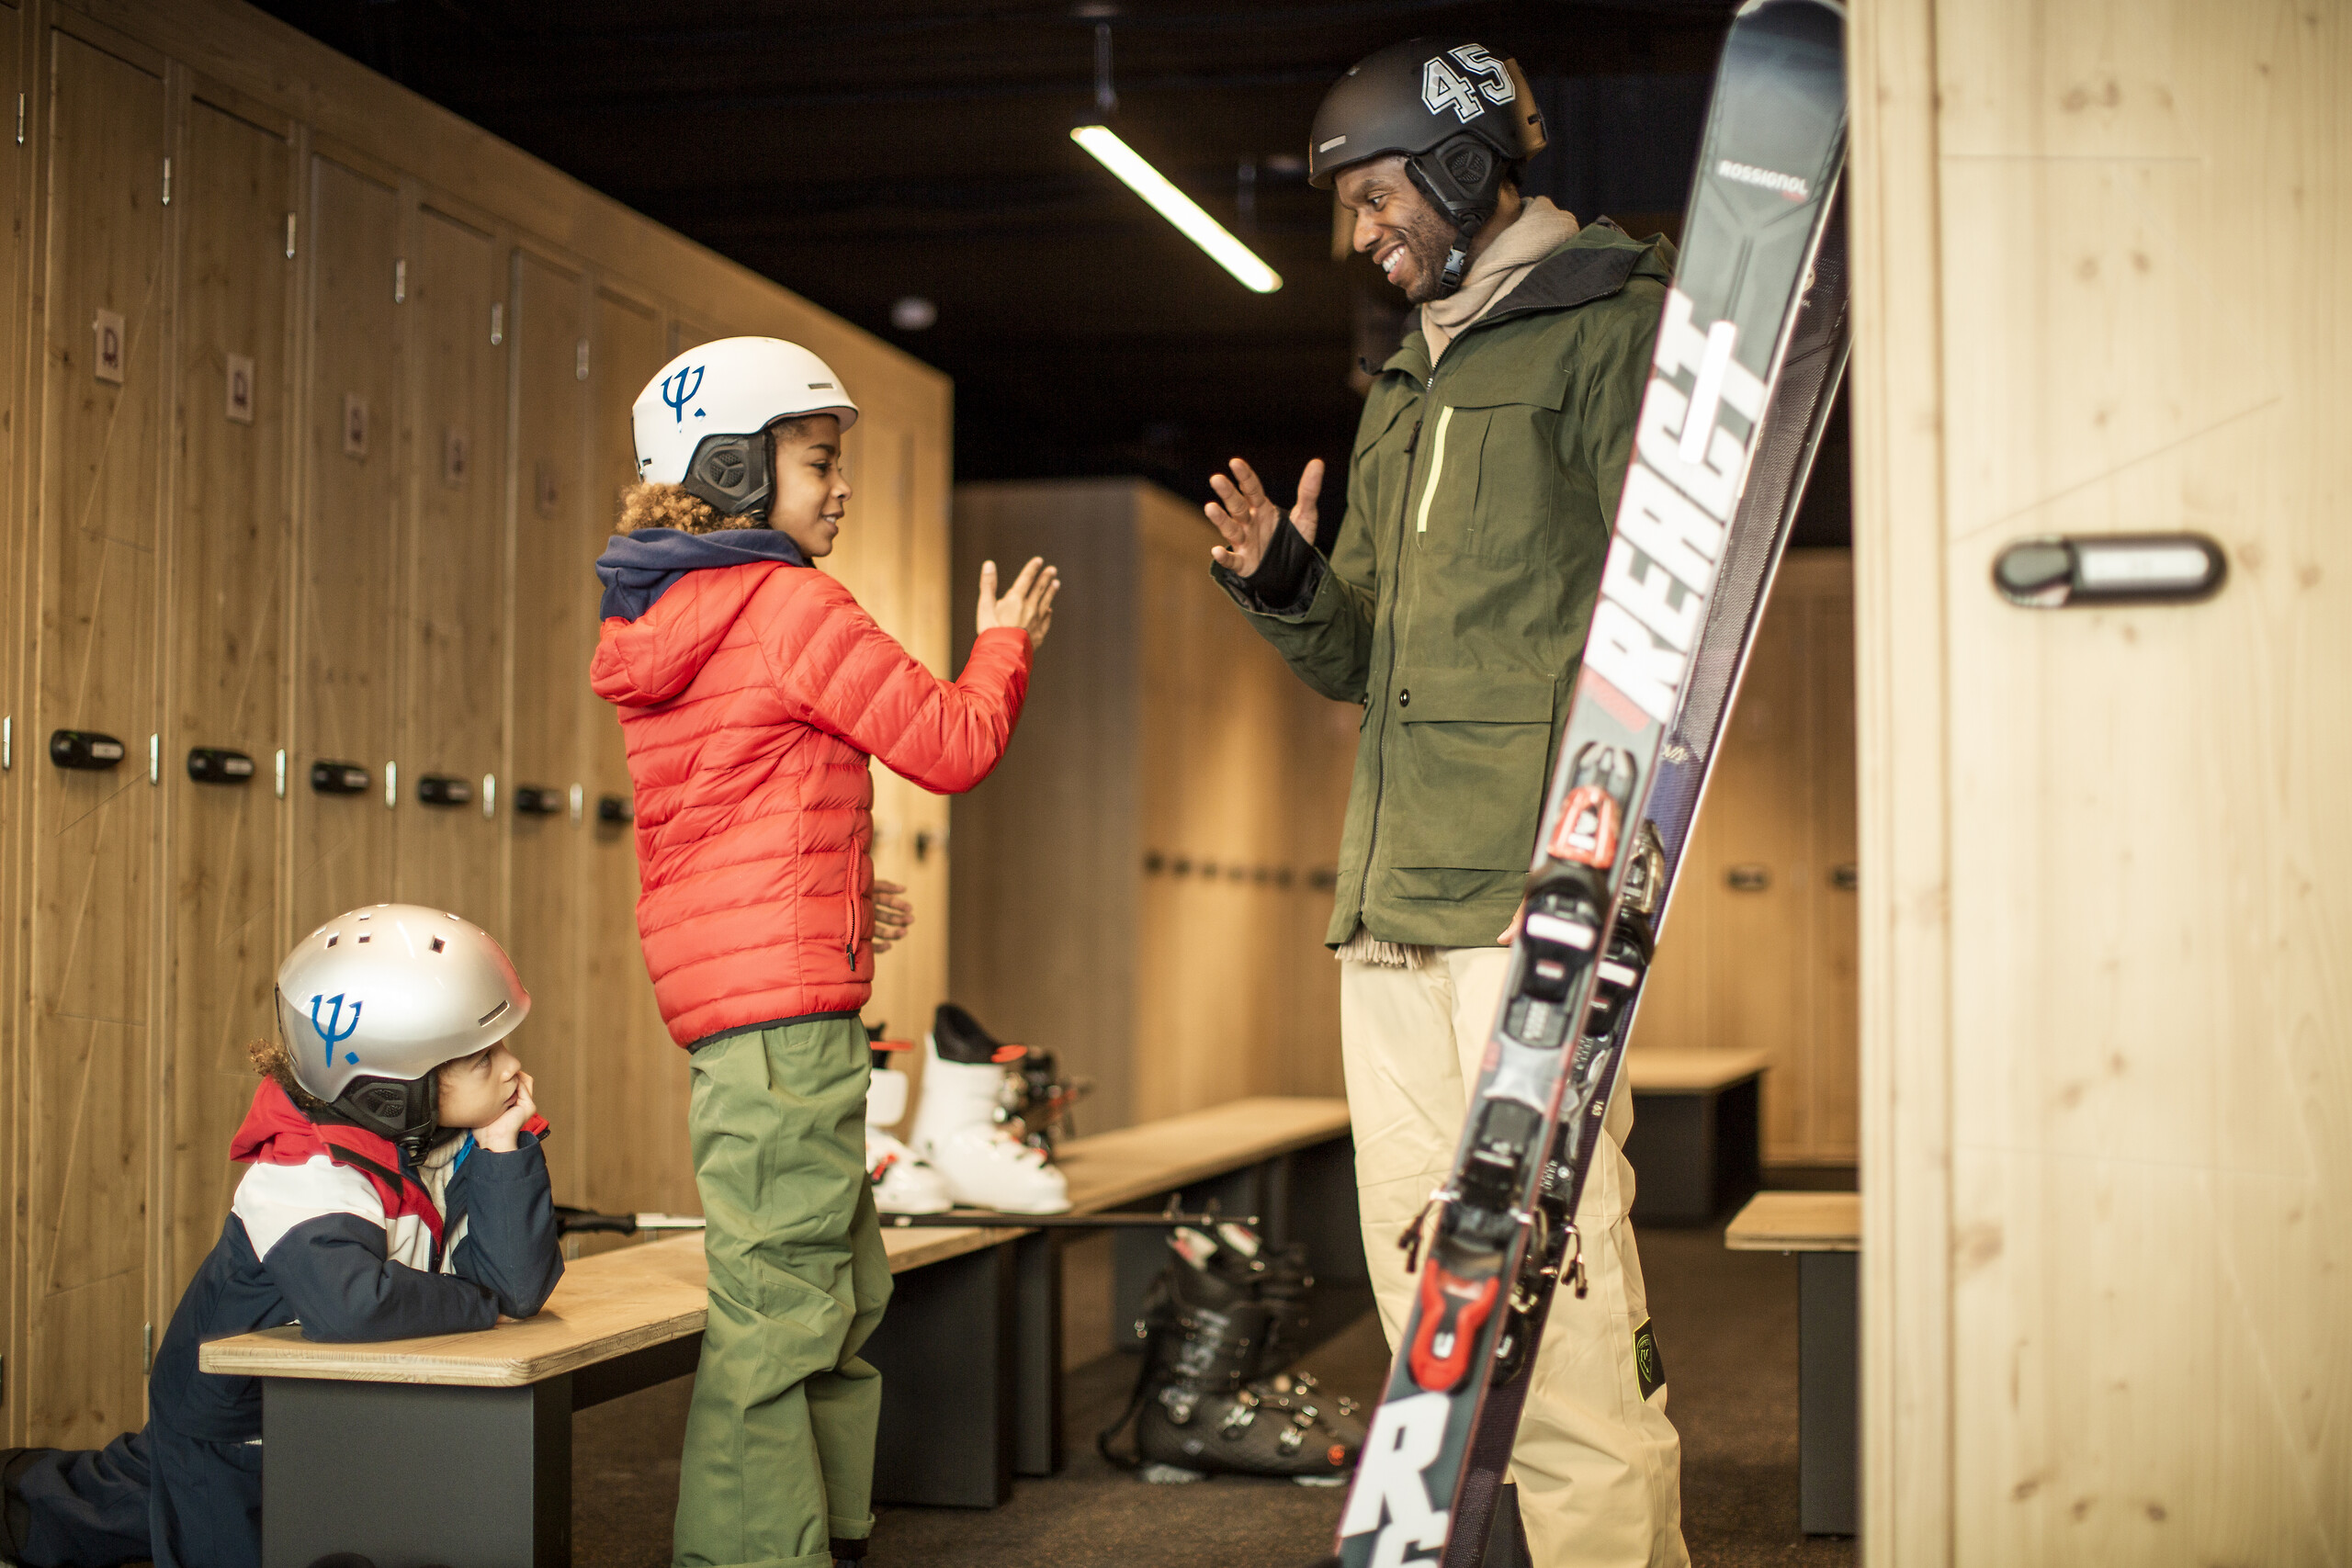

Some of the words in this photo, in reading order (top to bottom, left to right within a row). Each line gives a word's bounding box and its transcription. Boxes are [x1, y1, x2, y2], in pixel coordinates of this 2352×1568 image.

[1421, 43, 1516, 124] 45
[1717, 159, 1808, 196] ROSSIGNOL
[1583, 287, 1768, 726] REACT
